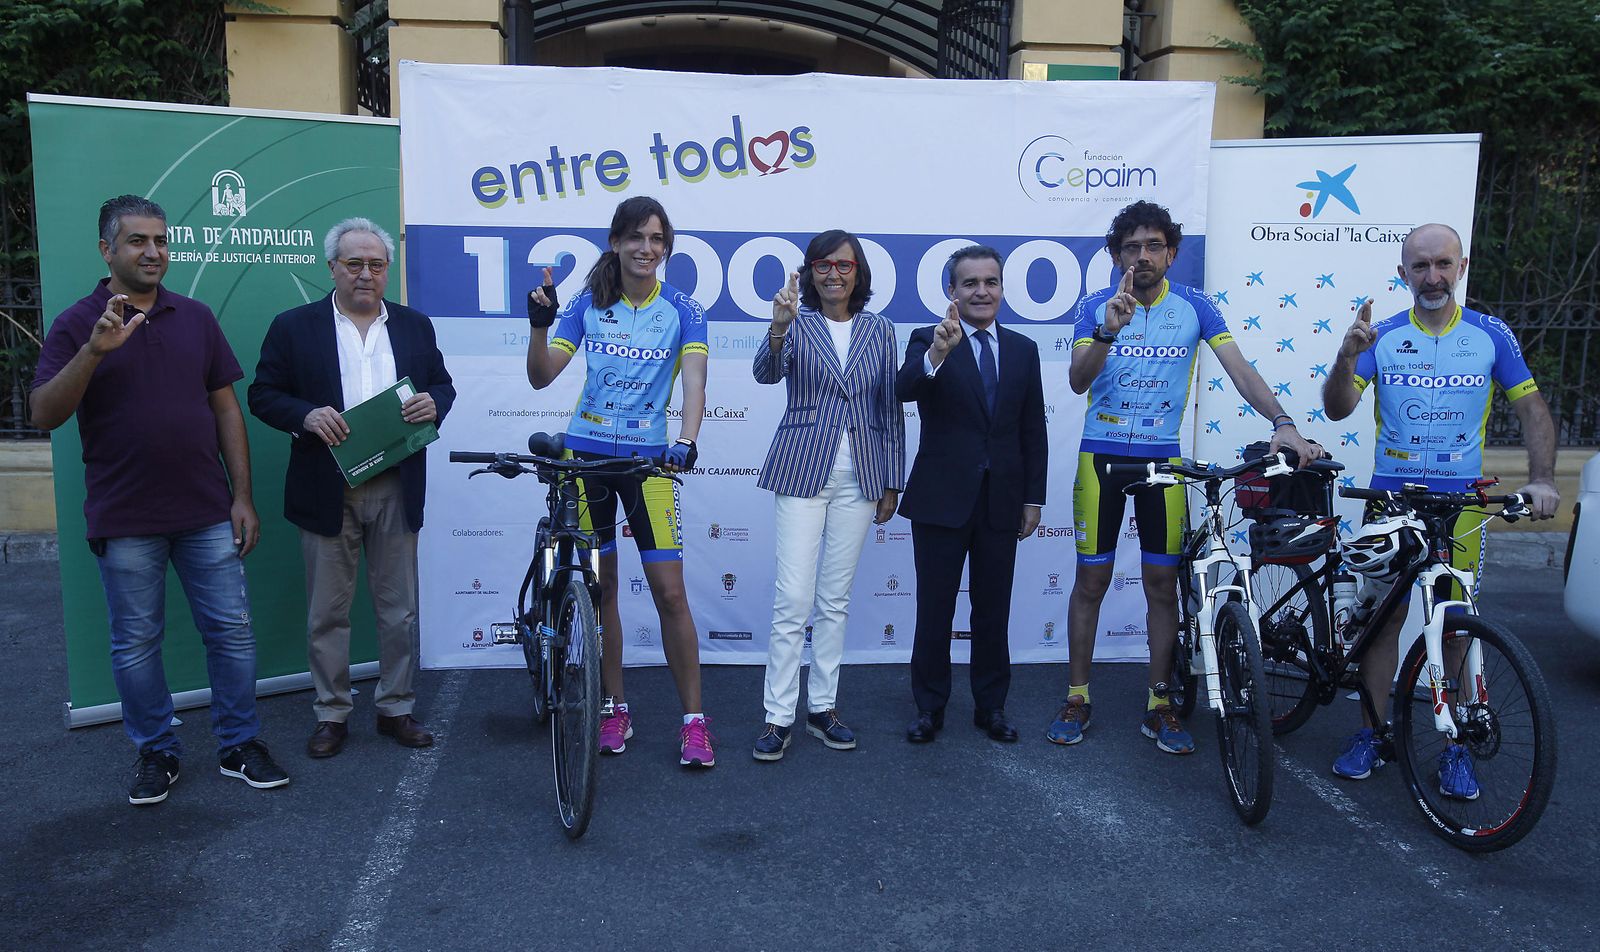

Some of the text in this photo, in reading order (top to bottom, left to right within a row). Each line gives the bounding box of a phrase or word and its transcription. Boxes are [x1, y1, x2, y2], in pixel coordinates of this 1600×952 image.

[471, 114, 817, 209] entre todos
[1084, 150, 1123, 161] fundación
[1035, 152, 1157, 194] Cepaim
[166, 226, 195, 244] NTA
[203, 227, 223, 245] DE
[1250, 225, 1290, 242] Obra
[1294, 226, 1340, 242] Social
[206, 252, 219, 263] DE
[221, 253, 262, 264] JUSTICIA
[265, 254, 270, 263] E
[273, 254, 316, 265] INTERIOR
[714, 335, 762, 349] 12 millo
[587, 341, 672, 360] 12 000 000
[1107, 345, 1188, 358] 2 000 000
[1382, 361, 1434, 372] entre todos
[604, 371, 652, 391] Cepaim
[1119, 373, 1169, 390] Cepaim
[1384, 374, 1485, 388] 12 000 000
[488, 409, 575, 418] Patrocinadores principale
[1406, 404, 1465, 423] Cepaim
[589, 430, 647, 443] #YoSoyRefugio
[1106, 431, 1158, 442] #YoSoyRefugio
[707, 467, 761, 476] CAJAMURCI
[1394, 467, 1457, 477] #YoSoyRefugio
[452, 528, 504, 538] Colaboradores:
[1046, 527, 1073, 537] Soria
